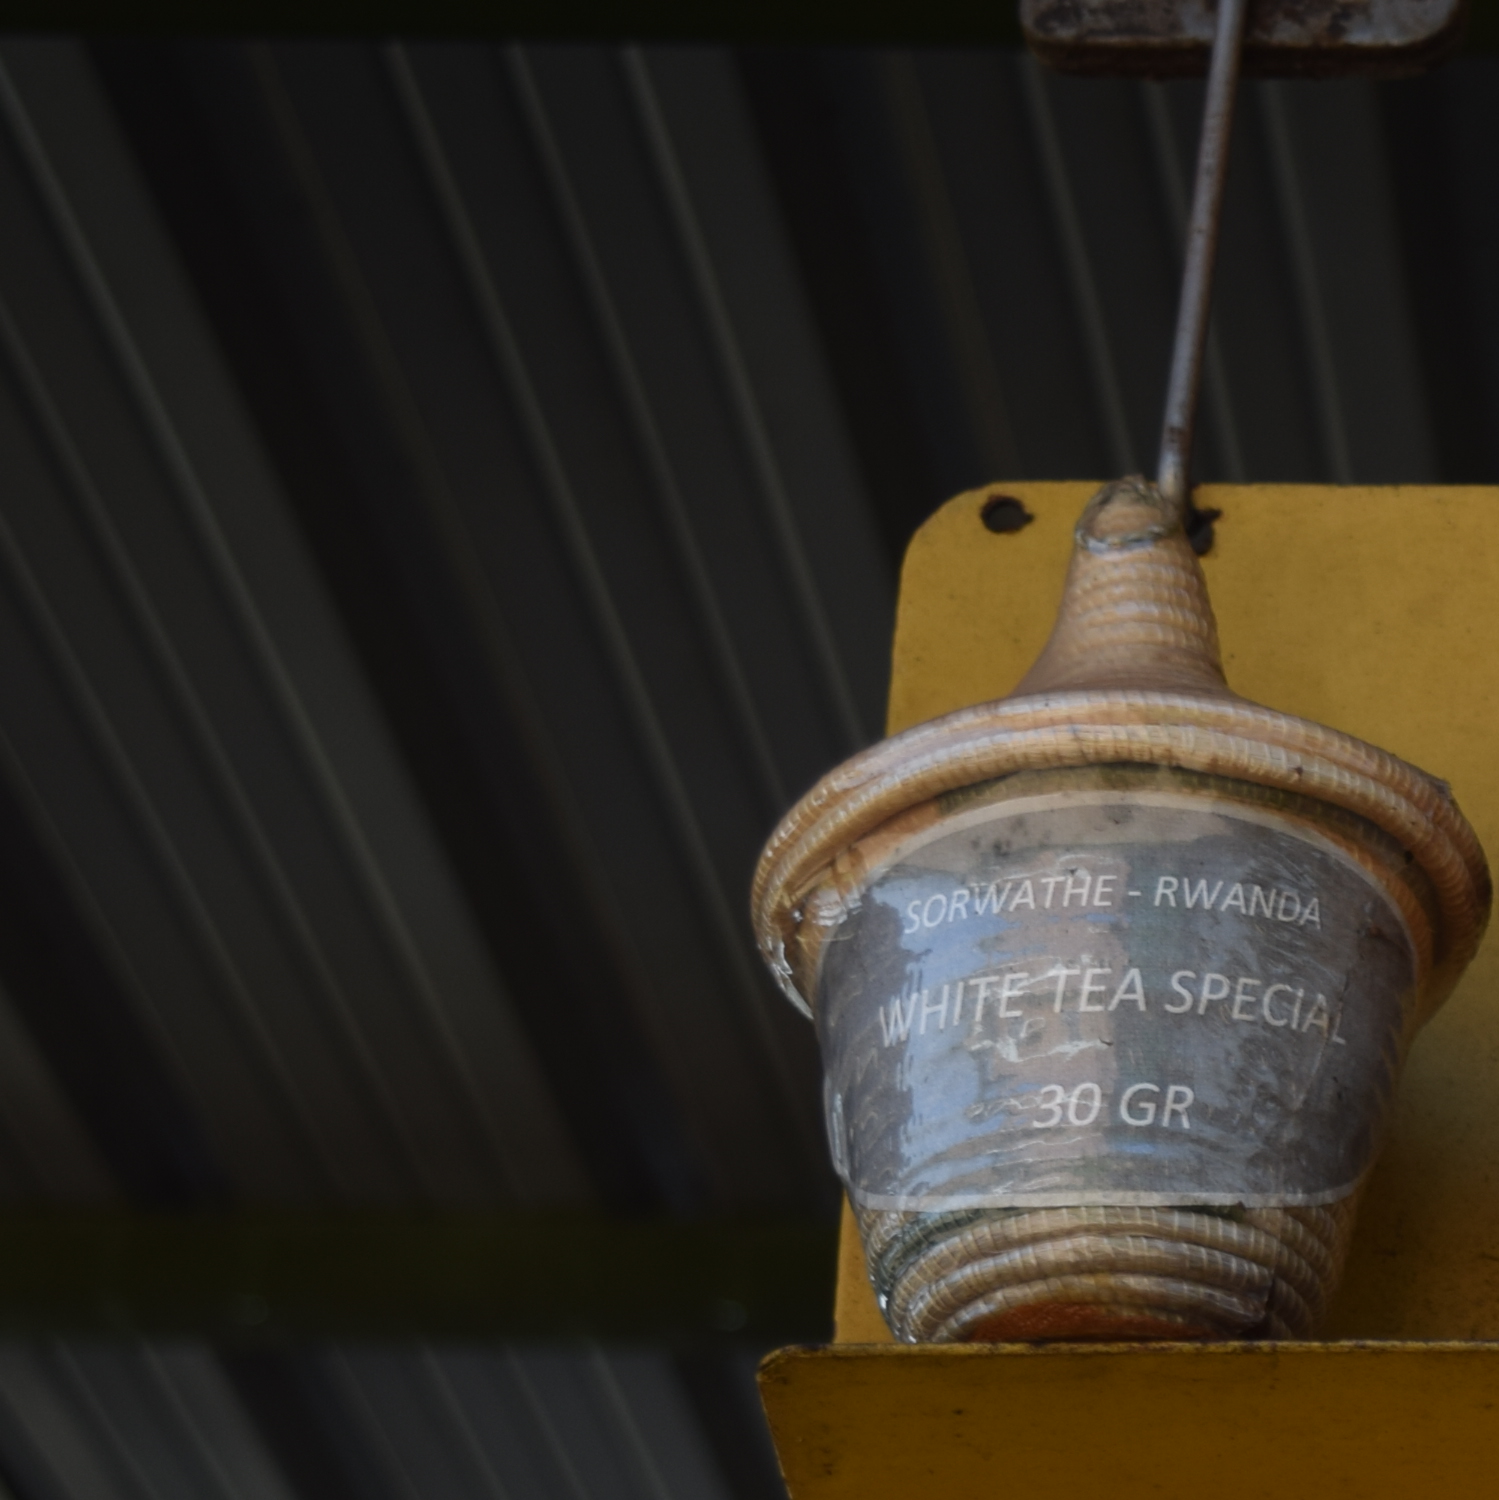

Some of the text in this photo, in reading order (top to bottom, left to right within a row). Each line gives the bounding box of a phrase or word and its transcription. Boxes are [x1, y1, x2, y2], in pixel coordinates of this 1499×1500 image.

[904, 875, 1114, 934] SORWATHE
[1153, 875, 1322, 928] RWANDA
[878, 968, 1347, 1048] WHITE TEA SPECIAL
[1032, 1082, 1195, 1130] 30 GR
